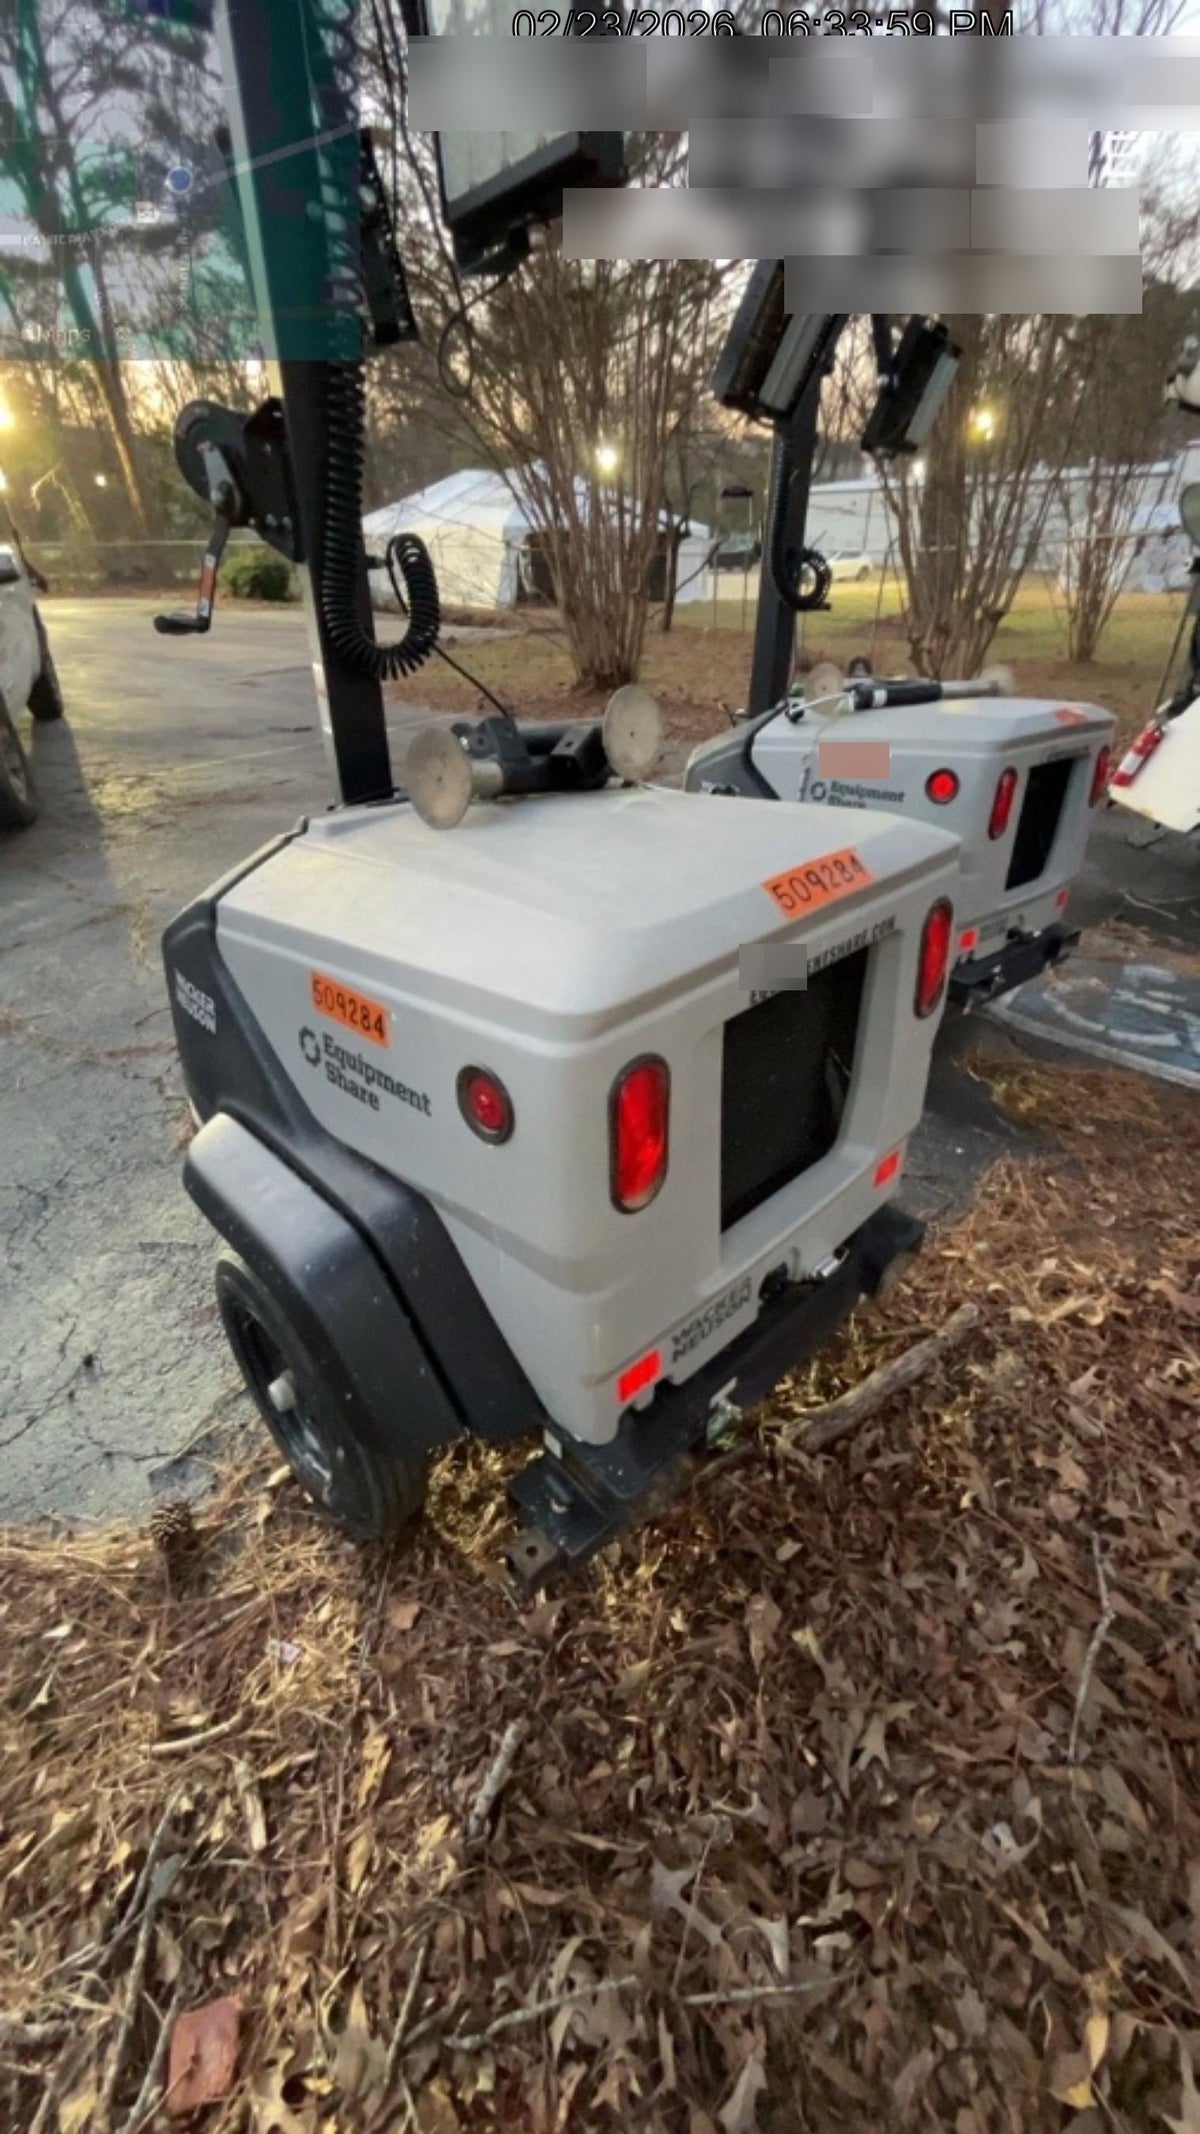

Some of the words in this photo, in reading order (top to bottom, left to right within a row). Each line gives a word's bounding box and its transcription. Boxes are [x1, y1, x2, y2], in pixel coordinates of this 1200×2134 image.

[772, 853, 866, 911] 509284
[312, 979, 386, 1039] 509284
[322, 1032, 432, 1117] Equipment
[325, 1060, 381, 1111] Share
